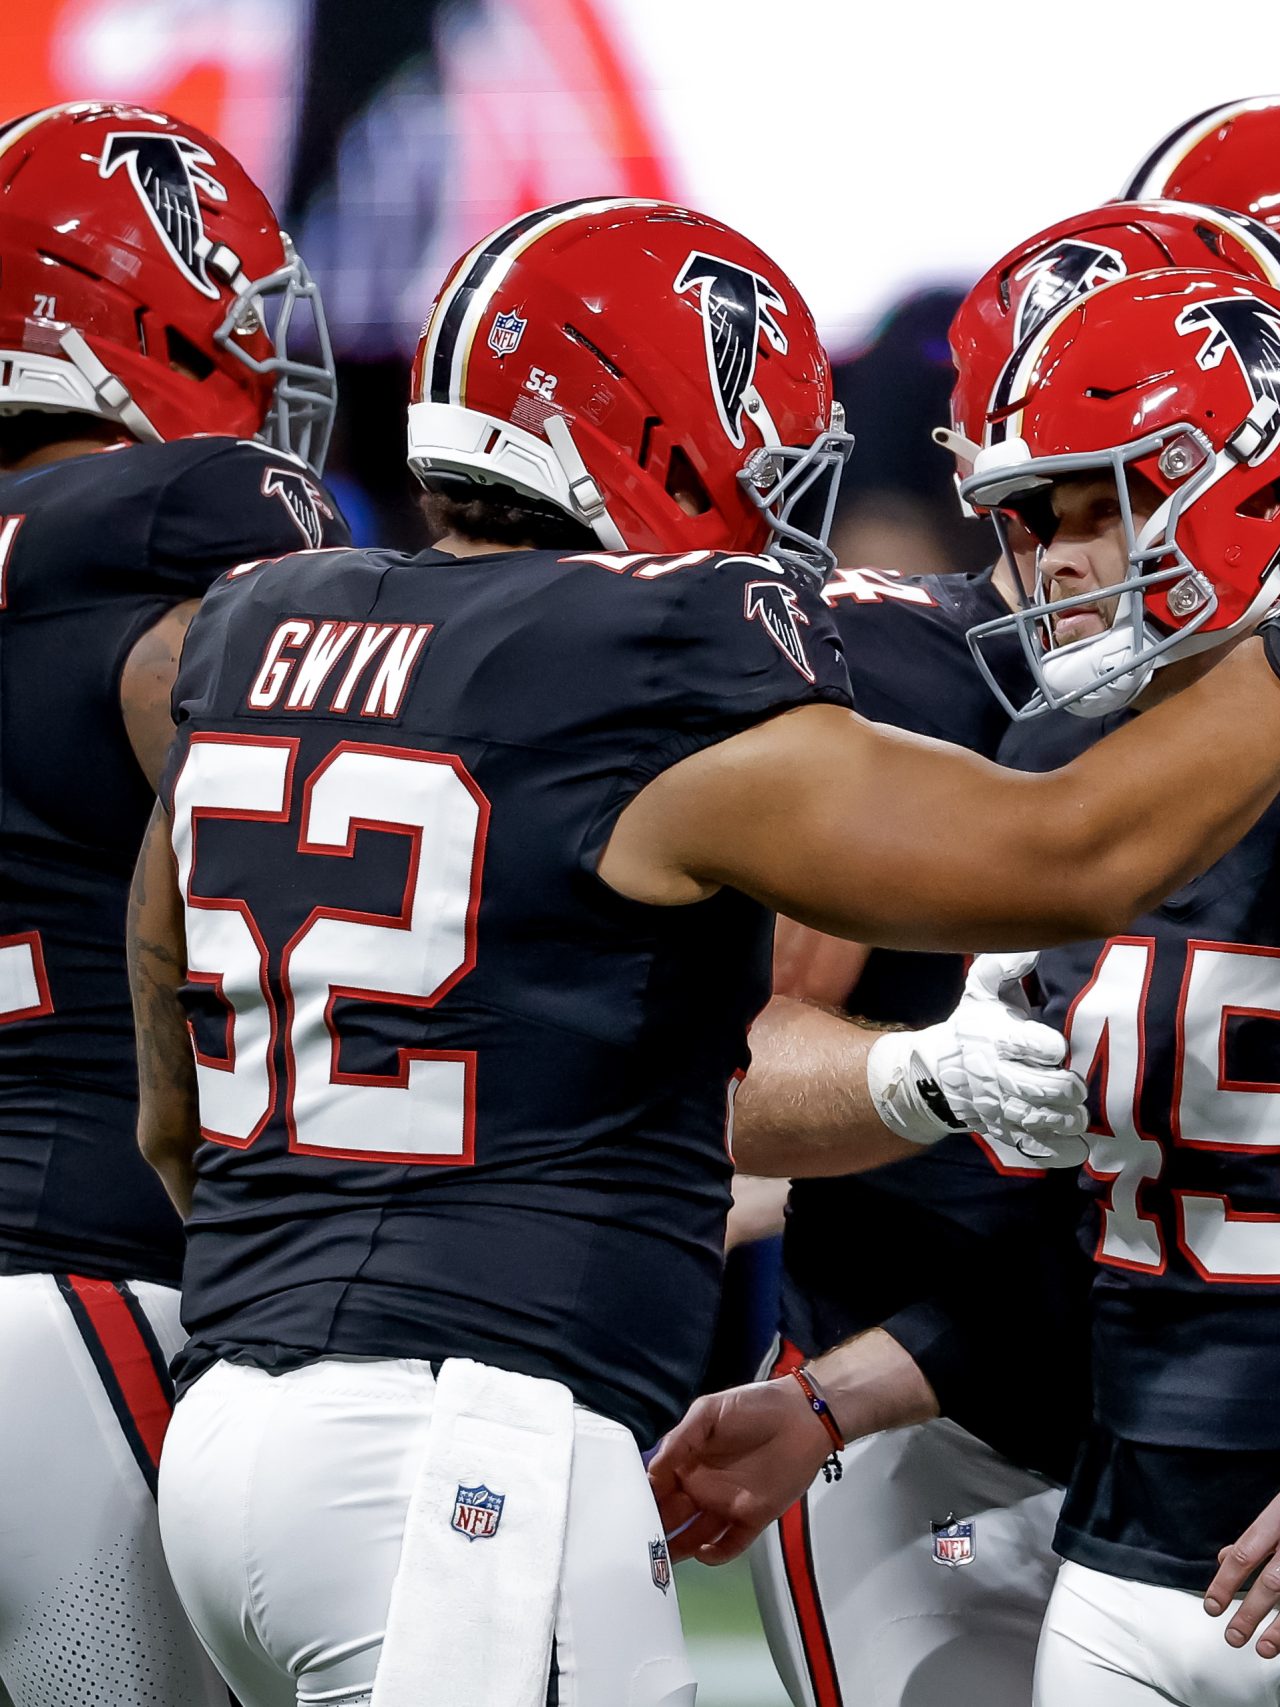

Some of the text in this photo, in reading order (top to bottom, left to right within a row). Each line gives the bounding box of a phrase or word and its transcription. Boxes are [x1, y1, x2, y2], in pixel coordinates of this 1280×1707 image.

[33, 294, 56, 319] 71
[492, 328, 515, 349] NFL
[525, 367, 558, 400] 52
[247, 617, 435, 720] GWYN
[170, 731, 492, 1166] 52
[455, 1505, 496, 1535] NFL
[938, 1540, 969, 1559] NFL
